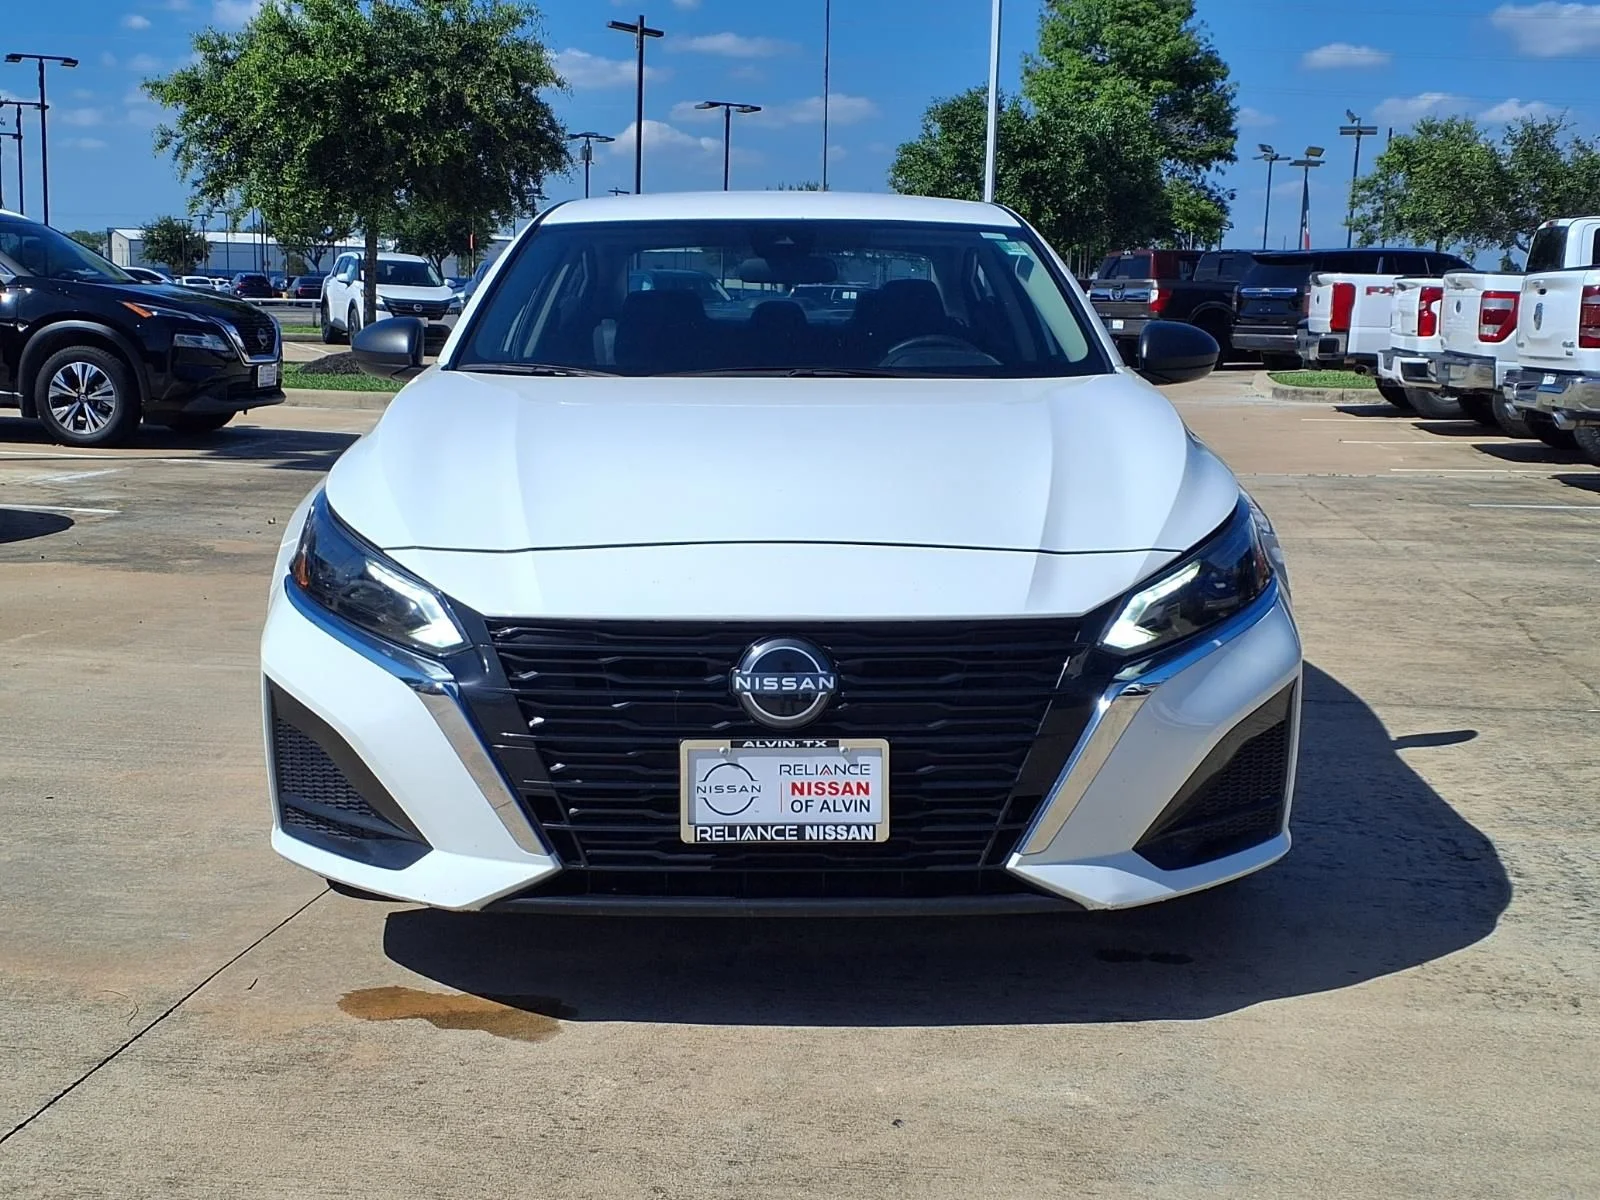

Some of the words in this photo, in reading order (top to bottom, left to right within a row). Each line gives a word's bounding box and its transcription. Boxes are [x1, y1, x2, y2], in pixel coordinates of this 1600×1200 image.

[735, 676, 835, 690] NISSAN
[803, 740, 828, 748] TX
[779, 764, 871, 776] RELIANCE
[696, 785, 762, 794] NISSAN
[790, 781, 870, 796] NISSAN
[790, 800, 814, 813] OF
[819, 800, 871, 813] ALVIN
[696, 825, 798, 841] RELIANCE
[805, 825, 874, 841] NISSAN
